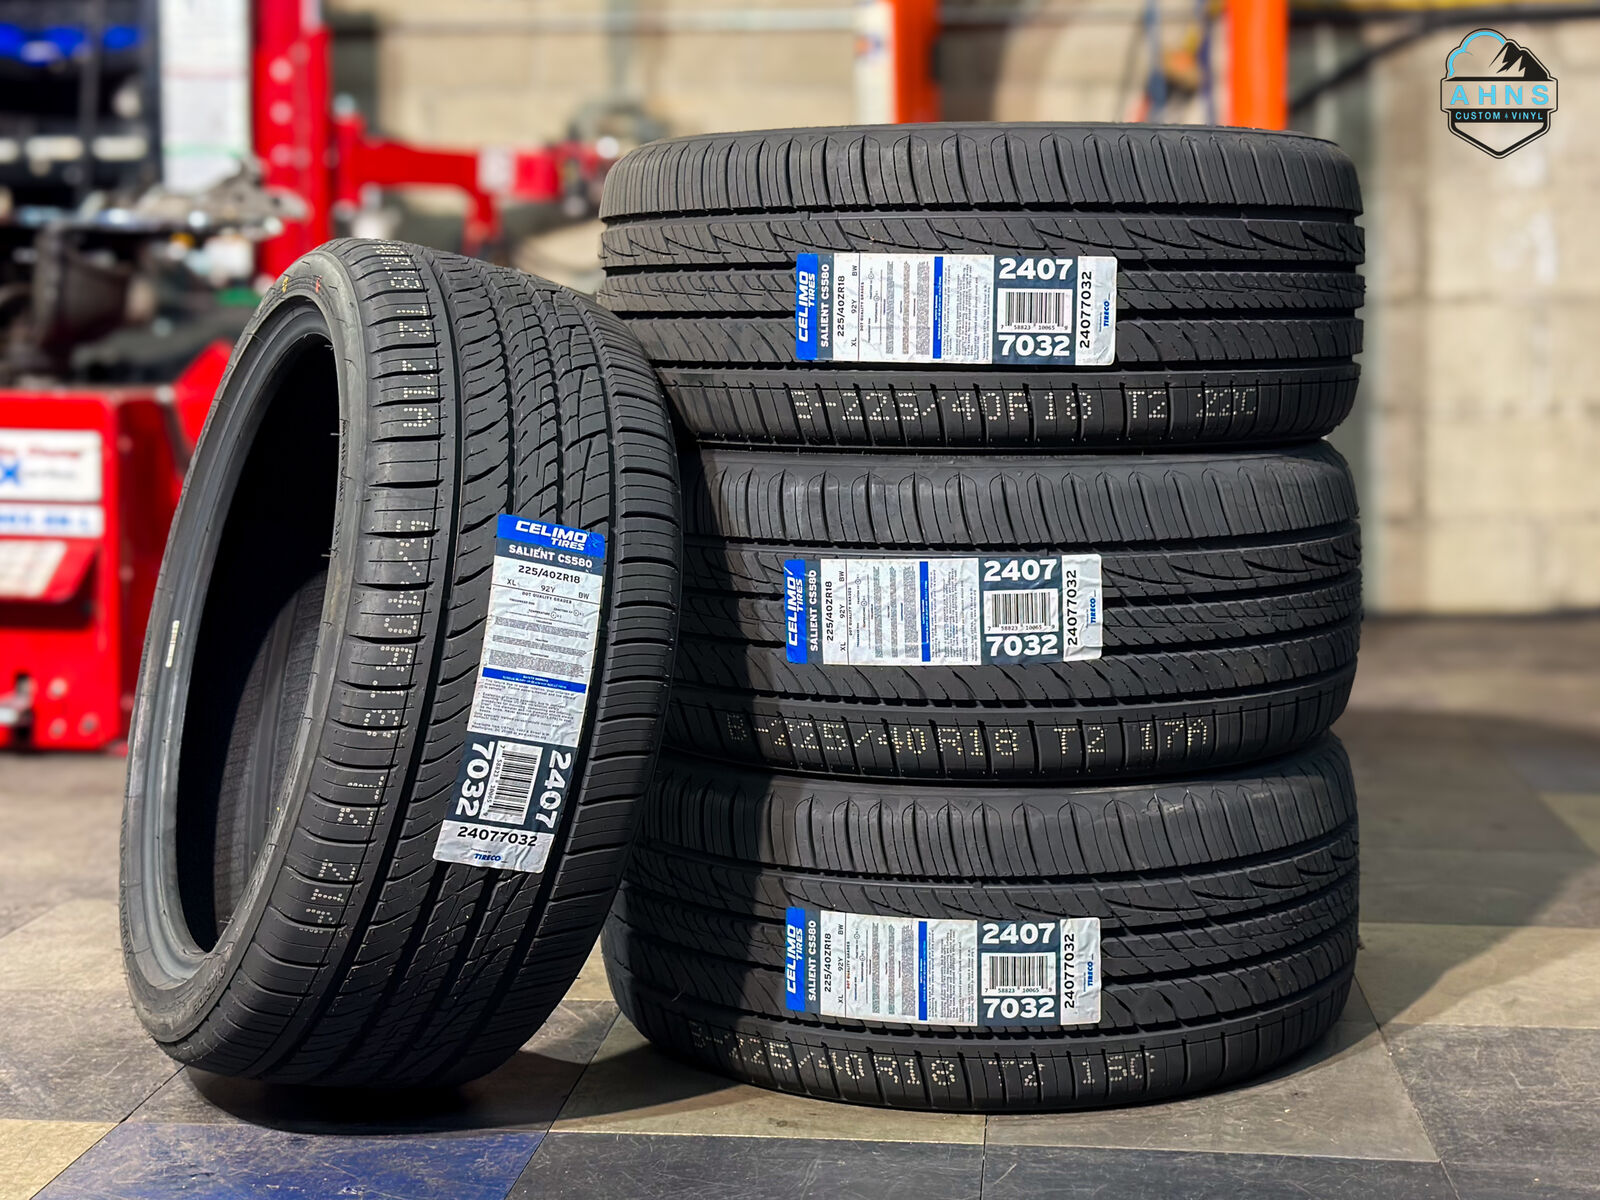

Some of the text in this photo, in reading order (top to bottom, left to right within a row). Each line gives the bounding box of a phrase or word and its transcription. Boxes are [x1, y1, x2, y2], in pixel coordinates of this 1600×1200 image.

[999, 257, 1073, 280] 2407
[808, 273, 816, 308] TIRES
[798, 271, 809, 342] CELIMO
[821, 264, 830, 347] SALIENT CS580
[837, 275, 845, 337] 225/40ZR18
[1080, 271, 1092, 348] 24077032
[851, 338, 857, 347] XL
[998, 335, 1070, 356] 7032
[1127, 391, 1167, 418] T2
[515, 520, 588, 543] CELIMO
[551, 537, 585, 551] TIRES
[509, 544, 593, 568] SALIENT CS580
[984, 559, 1057, 581] 2407
[507, 578, 516, 586] XL
[540, 584, 555, 593] 92Y
[518, 565, 581, 584] 225/40ZR18
[796, 578, 804, 612] TIRES
[1066, 570, 1077, 646] 24077032
[787, 576, 798, 646] CELIMO
[808, 570, 818, 651] SALIENT CS580
[825, 580, 834, 641] 225/40ZR18
[840, 642, 846, 651] XL
[986, 634, 1058, 657] 7032
[1053, 726, 1104, 754] T2
[455, 741, 495, 817] 7032
[535, 749, 572, 829] 2407
[457, 826, 538, 847] 24077032
[474, 853, 502, 861] TIRECO
[795, 927, 803, 961] TIRES
[982, 922, 1055, 944] 2407
[787, 924, 797, 994] CELIMO
[808, 920, 817, 1001] SALIENT CS580
[824, 933, 832, 993] 225/40ZR18
[1064, 933, 1075, 1009] 24077032
[838, 995, 844, 1004] XL
[983, 997, 1055, 1019] 7032
